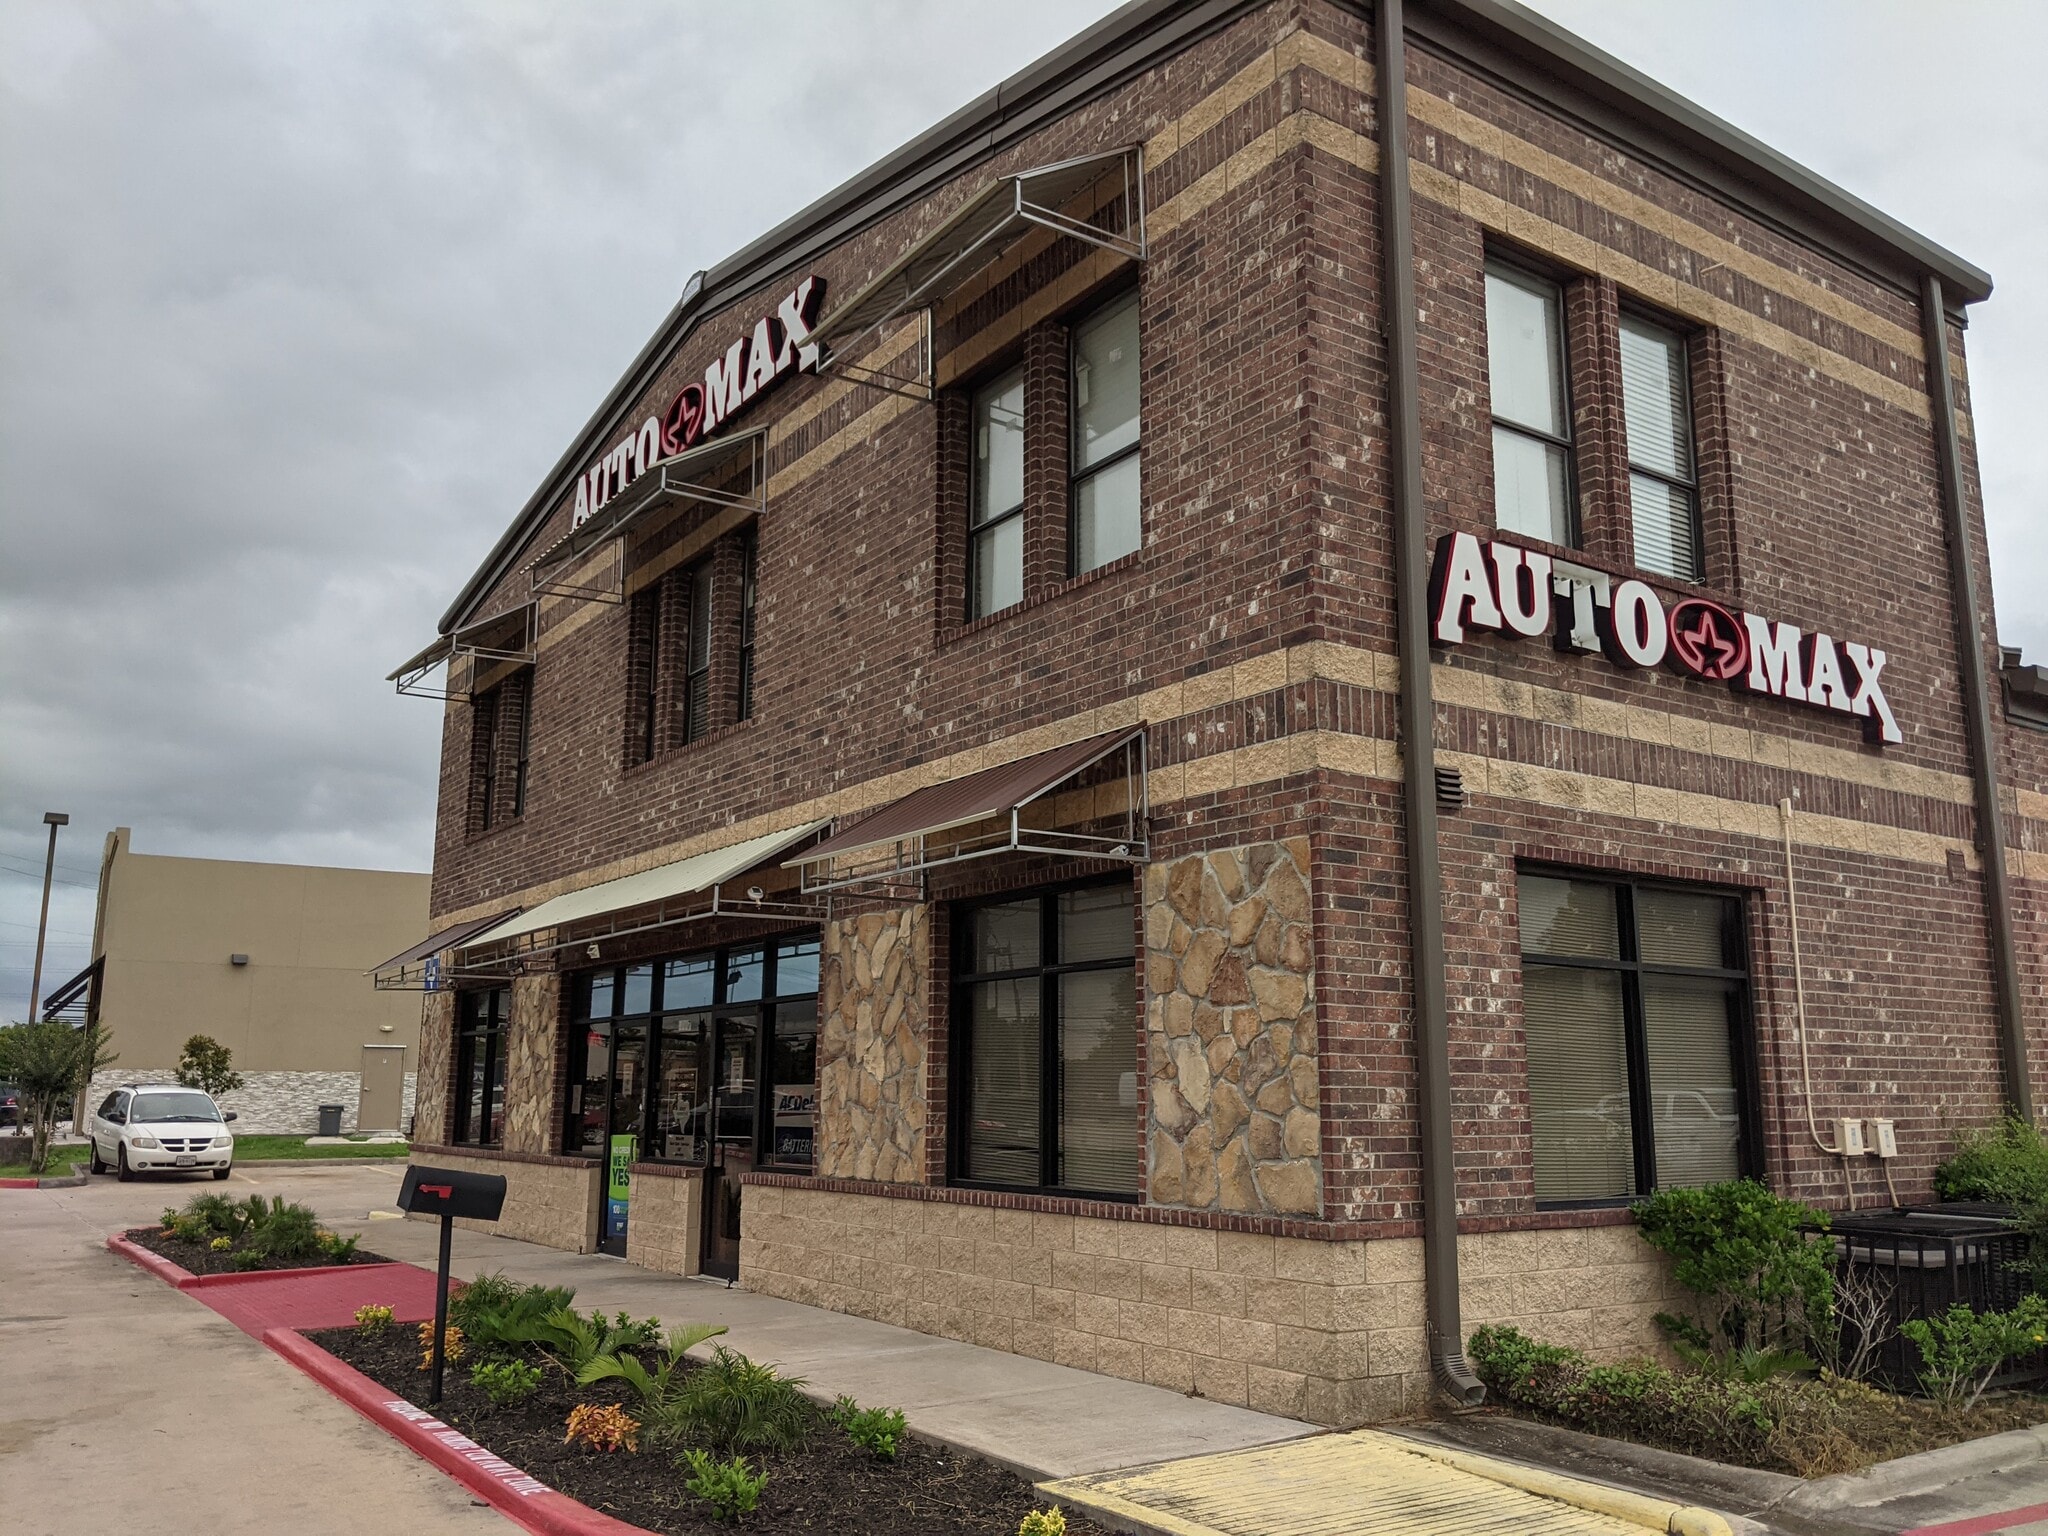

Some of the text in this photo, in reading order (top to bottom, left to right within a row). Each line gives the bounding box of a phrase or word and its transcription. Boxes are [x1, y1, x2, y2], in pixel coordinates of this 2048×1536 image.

[572, 275, 822, 532] AUTO MAX
[1430, 531, 1903, 745] AUTO MAX
[779, 1094, 816, 1111] ACDel
[781, 1138, 813, 1153] BATTERI
[612, 1155, 622, 1167] WE
[612, 1167, 630, 1187] YES
